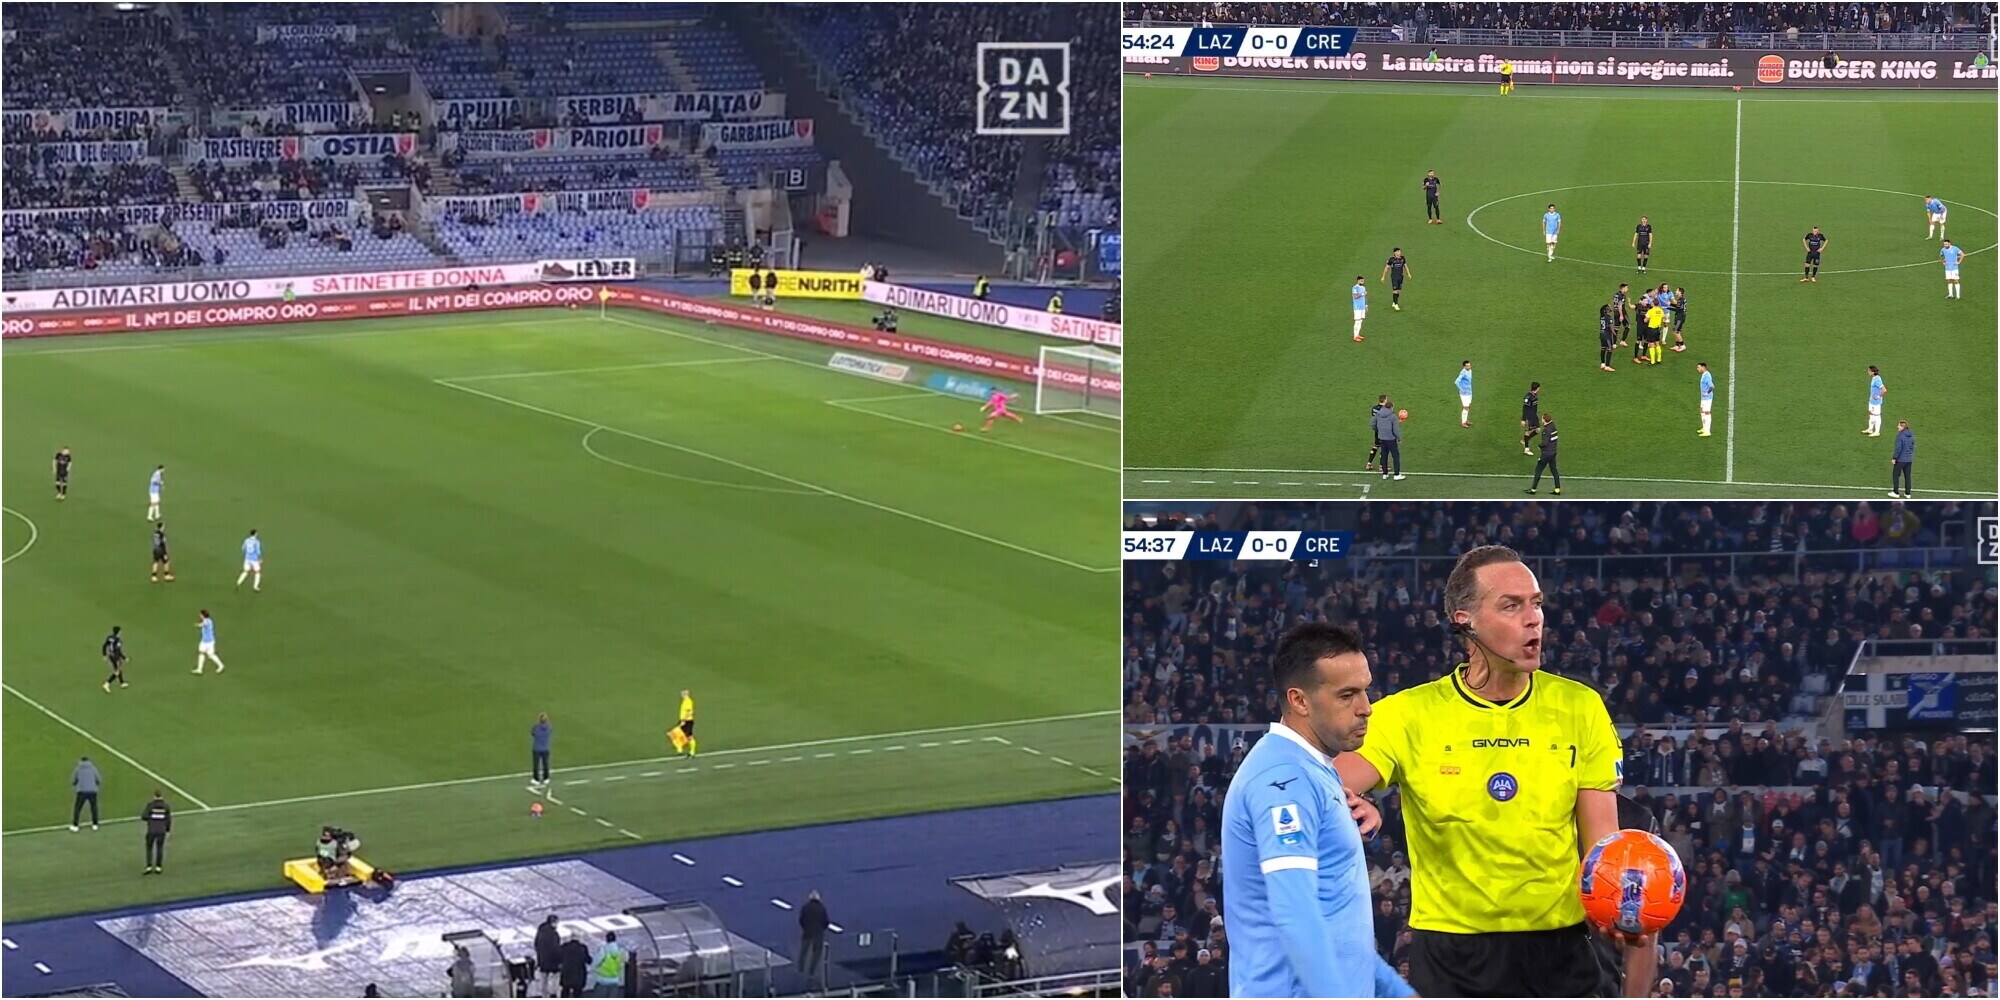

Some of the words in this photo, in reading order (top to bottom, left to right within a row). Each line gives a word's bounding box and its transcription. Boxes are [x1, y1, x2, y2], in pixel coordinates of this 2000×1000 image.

[1314, 53, 1367, 70] KING
[1382, 53, 1406, 71] La
[1409, 55, 1474, 73] nostra
[1556, 58, 1594, 75] non
[1597, 57, 1615, 76] si
[1617, 60, 1688, 81] spegne
[1691, 58, 1734, 77] mai.
[1788, 60, 1876, 79] BURGER
[1881, 60, 1936, 79] KING
[1953, 61, 1978, 79] La
[1759, 68, 1782, 77] KING
[285, 103, 349, 123] RIMINI
[447, 100, 521, 121] APULIA
[568, 97, 636, 117] SERBIA
[75, 110, 149, 130] MADEIRA
[571, 129, 645, 148] PARIOLI
[721, 121, 795, 144] GARBATELLA
[80, 144, 98, 162] DEL
[100, 142, 132, 162] GIGLIO
[204, 138, 282, 159] TRASTEVERE
[323, 136, 396, 155] OSTIA
[791, 169, 802, 184] B
[308, 201, 349, 219] CUORI
[446, 198, 478, 215] APPIO
[483, 196, 522, 213] LATINO
[556, 193, 582, 212] VIALE
[313, 272, 427, 293] SATINETTE
[432, 267, 506, 286] DONNA
[798, 278, 861, 294] NURITH
[53, 286, 163, 308] ADIMARI
[173, 281, 251, 302] UOMO
[126, 314, 142, 327] IL
[174, 310, 202, 325] DEI
[205, 305, 278, 323] COMPRO
[281, 303, 317, 319] ORO
[409, 297, 423, 311] IL
[454, 293, 480, 308] DEI
[483, 288, 552, 306] COMPRO
[556, 287, 593, 302] ORO
[693, 303, 723, 318] COMPRO
[723, 308, 739, 320] ORO
[886, 286, 952, 315] ADIMARI
[957, 299, 1009, 325] UOMO
[797, 321, 828, 337] COMPRO
[828, 328, 846, 340] ORO
[926, 346, 939, 356] DEI
[939, 348, 973, 366] COMPRO
[973, 355, 993, 368] ORO
[1472, 738, 1530, 748] GIVOVA
